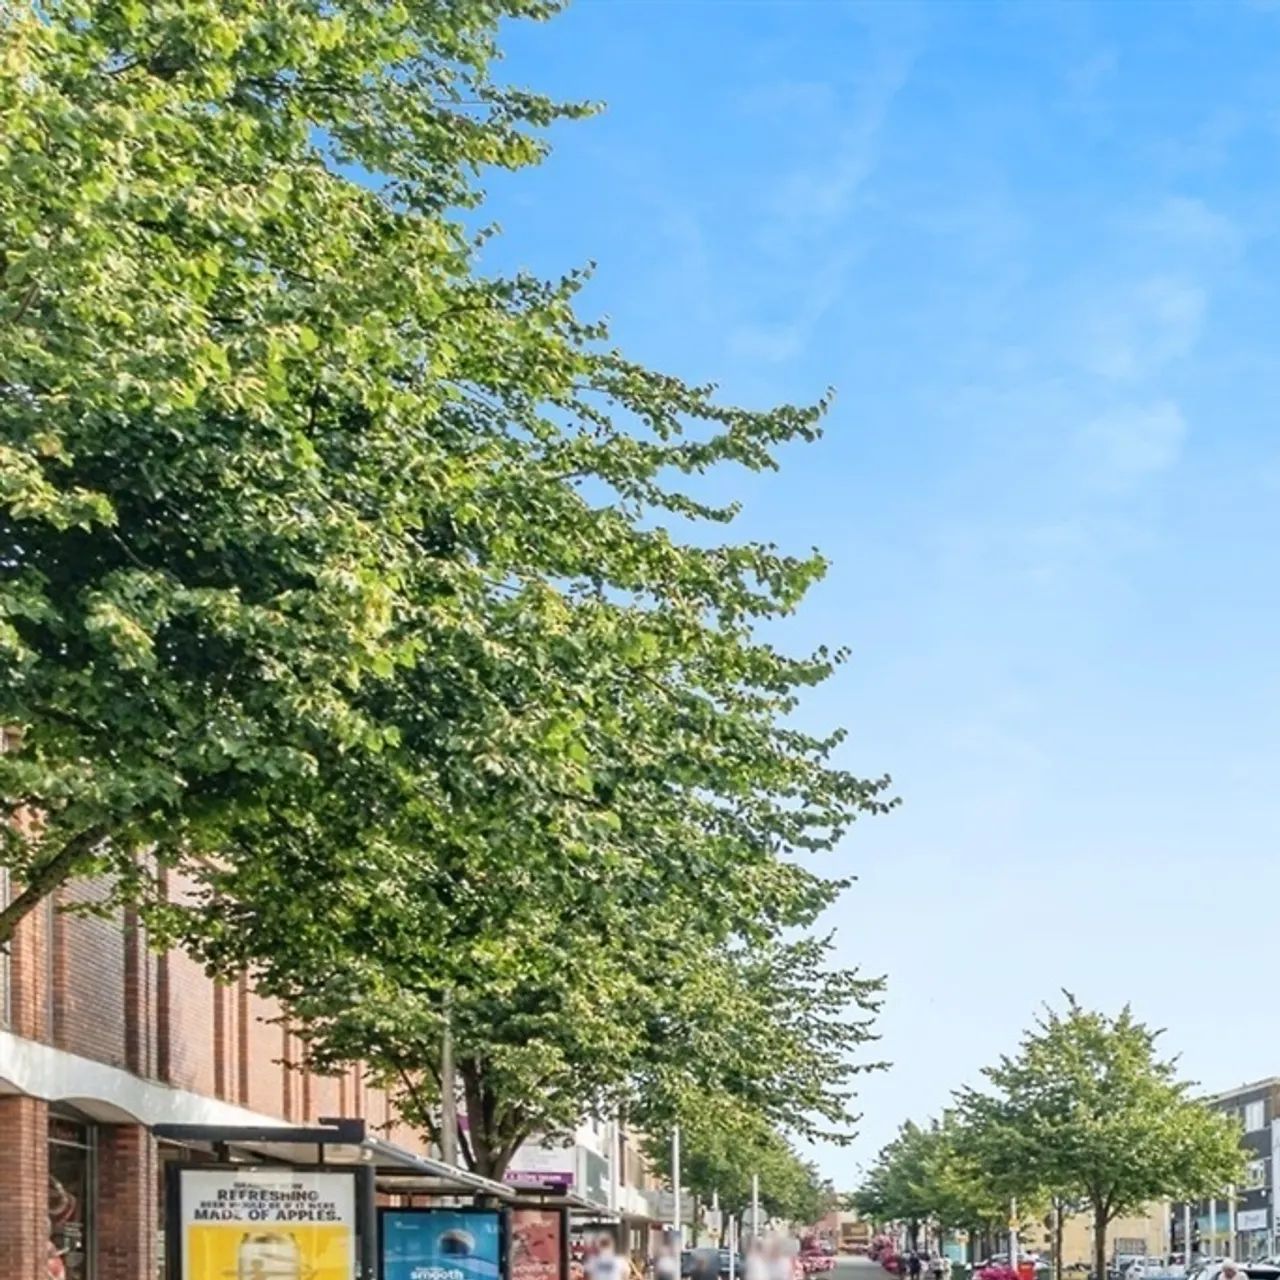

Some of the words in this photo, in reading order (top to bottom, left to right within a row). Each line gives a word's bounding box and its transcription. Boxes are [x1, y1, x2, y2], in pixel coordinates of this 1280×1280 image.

[217, 1189, 320, 1201] REFRESHING
[248, 1209, 270, 1221] OF
[275, 1209, 343, 1222] APPLES.
